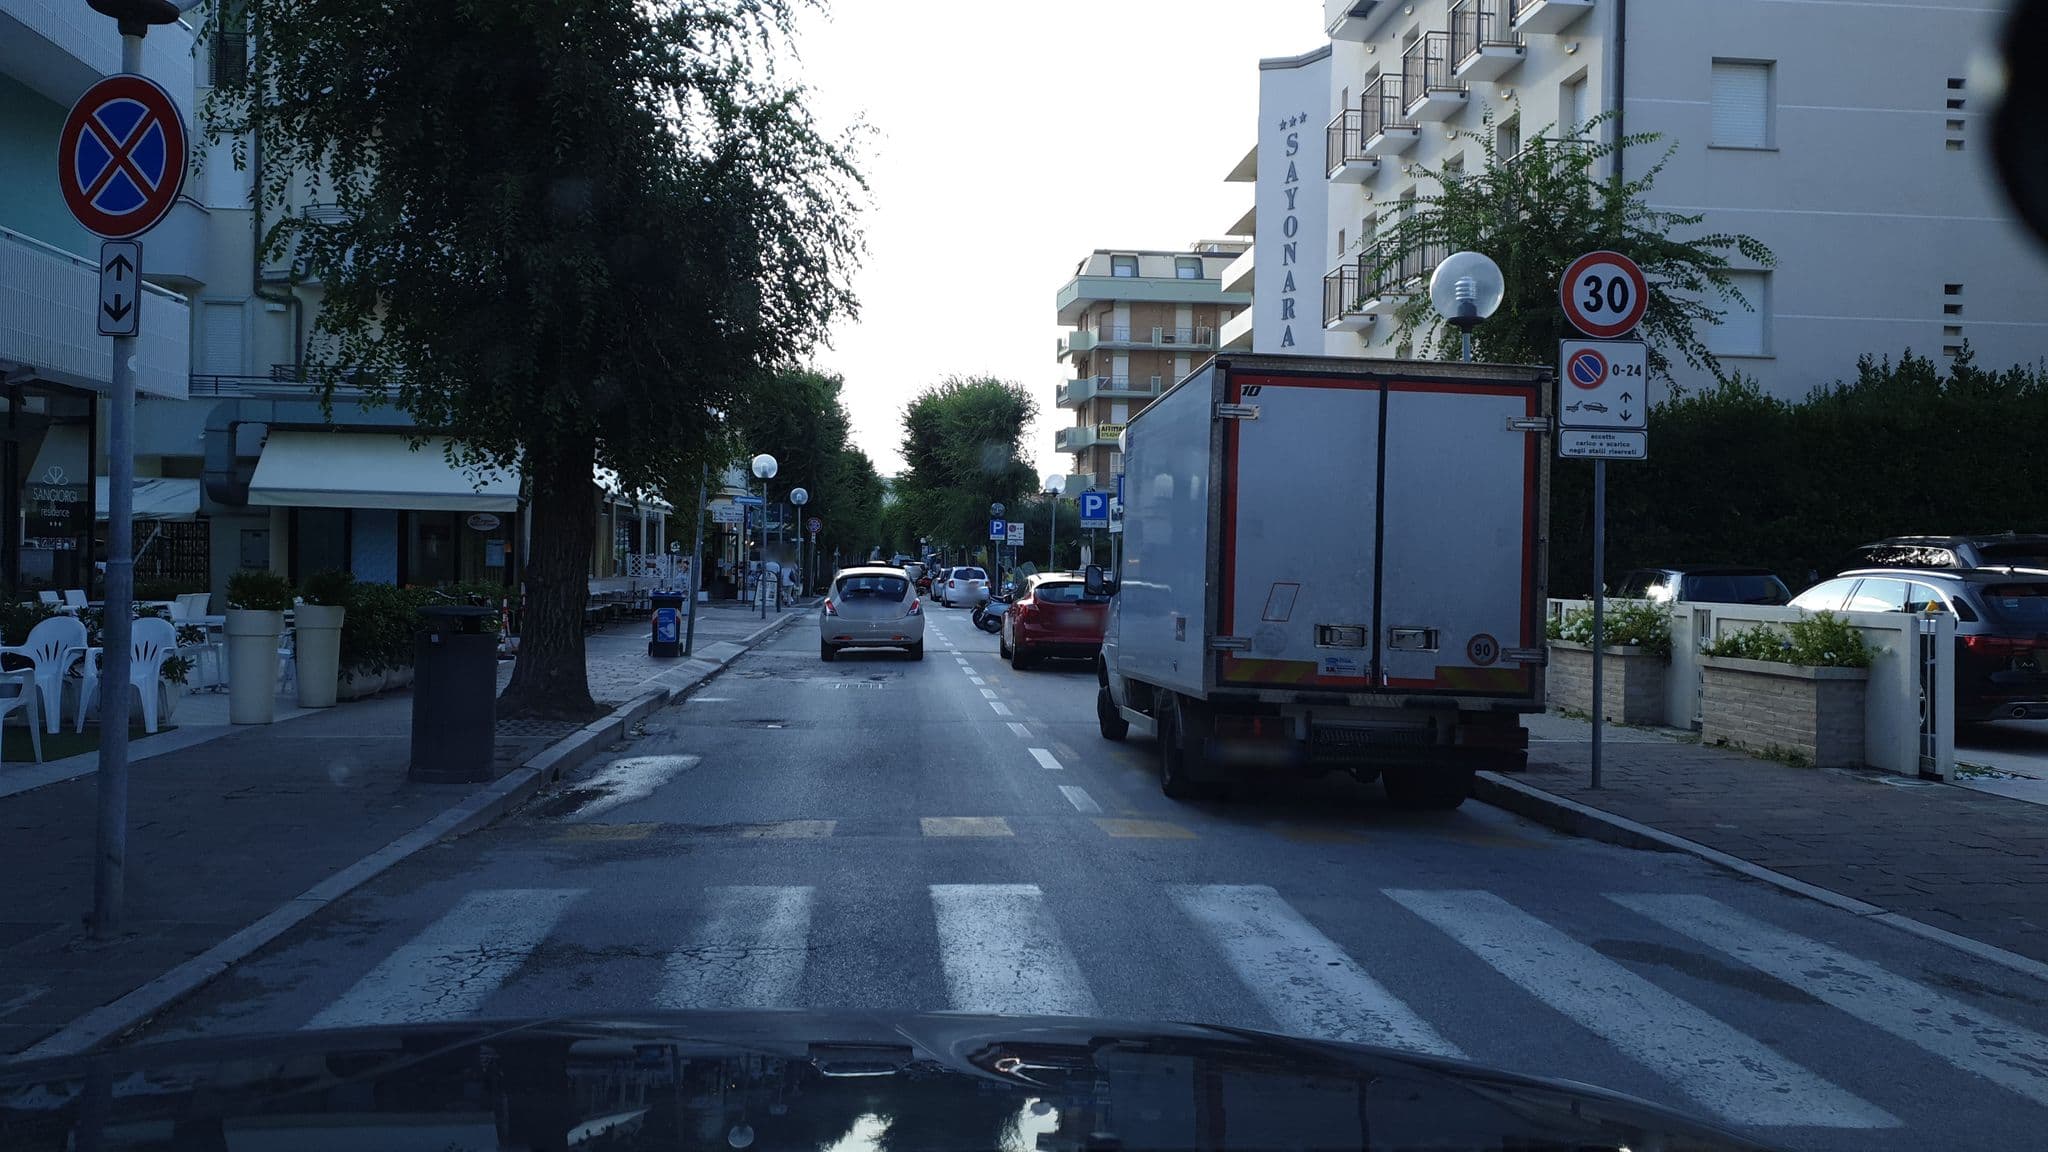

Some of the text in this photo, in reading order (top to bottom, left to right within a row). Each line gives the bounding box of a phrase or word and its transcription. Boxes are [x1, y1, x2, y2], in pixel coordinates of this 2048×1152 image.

[1281, 132, 1299, 348] SAYONARA
[1584, 275, 1628, 313] 30
[1612, 364, 1641, 377] 0-24
[32, 487, 79, 503] SANGIORGI
[1085, 495, 1103, 517] P
[993, 521, 1003, 534] P
[1475, 643, 1490, 657] 90
